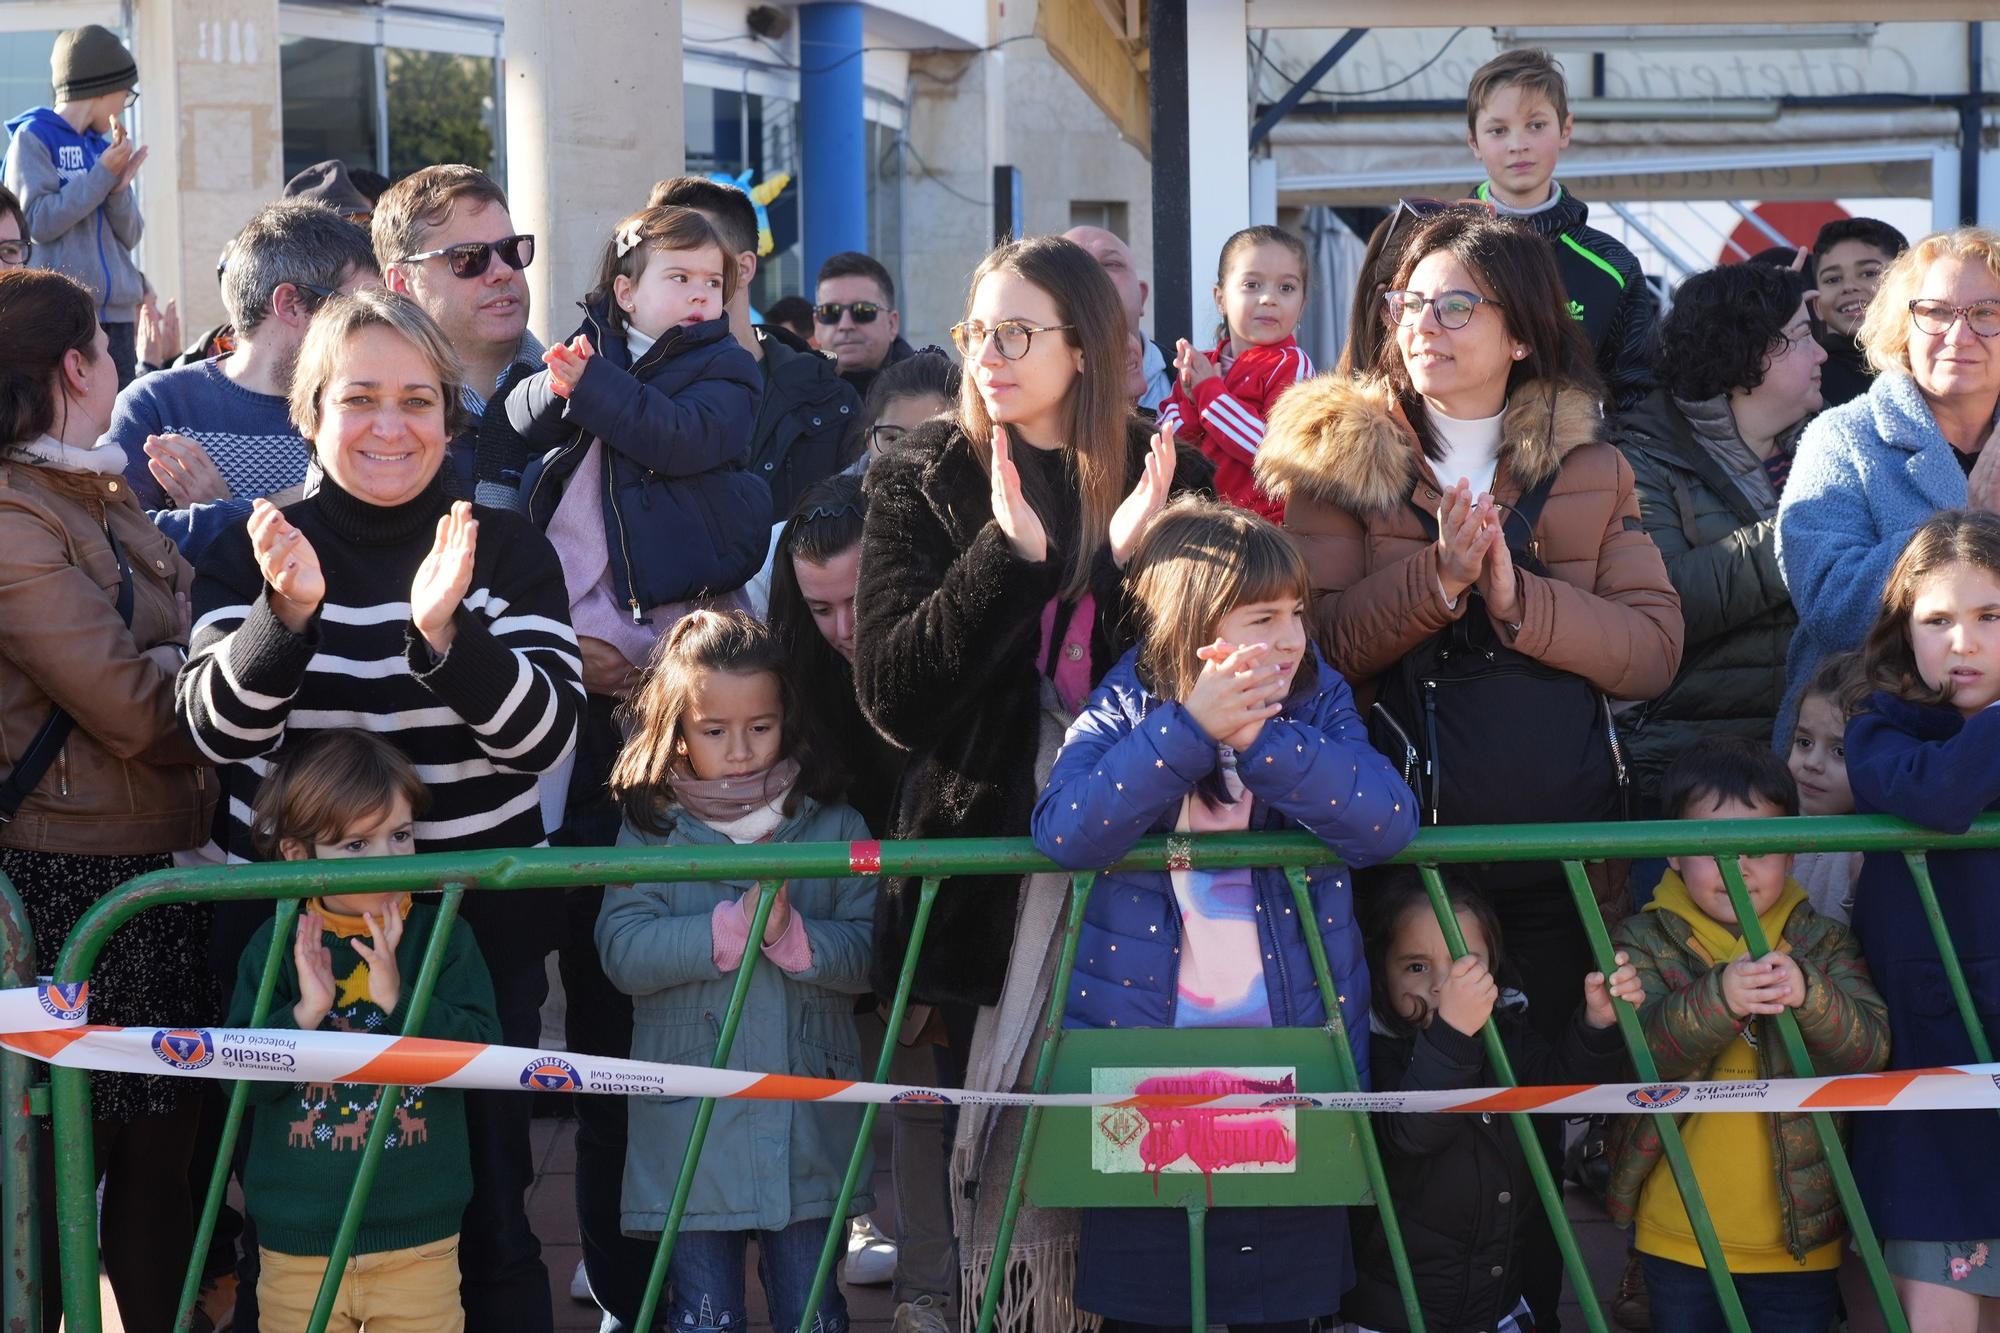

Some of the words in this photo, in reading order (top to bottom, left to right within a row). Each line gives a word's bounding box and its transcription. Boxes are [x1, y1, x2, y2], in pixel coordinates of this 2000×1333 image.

[40, 993, 59, 1015] CIVIL
[223, 1033, 245, 1044] Civil
[248, 1035, 296, 1050] Protecció
[221, 1047, 295, 1067] Castelló
[222, 1060, 236, 1069] de
[239, 1062, 296, 1073] Ajuntament
[527, 1058, 572, 1073] CASTELLO
[591, 1070, 612, 1079] Civil
[615, 1071, 664, 1084] Protecció
[1709, 1090, 1768, 1101] Ajuntament
